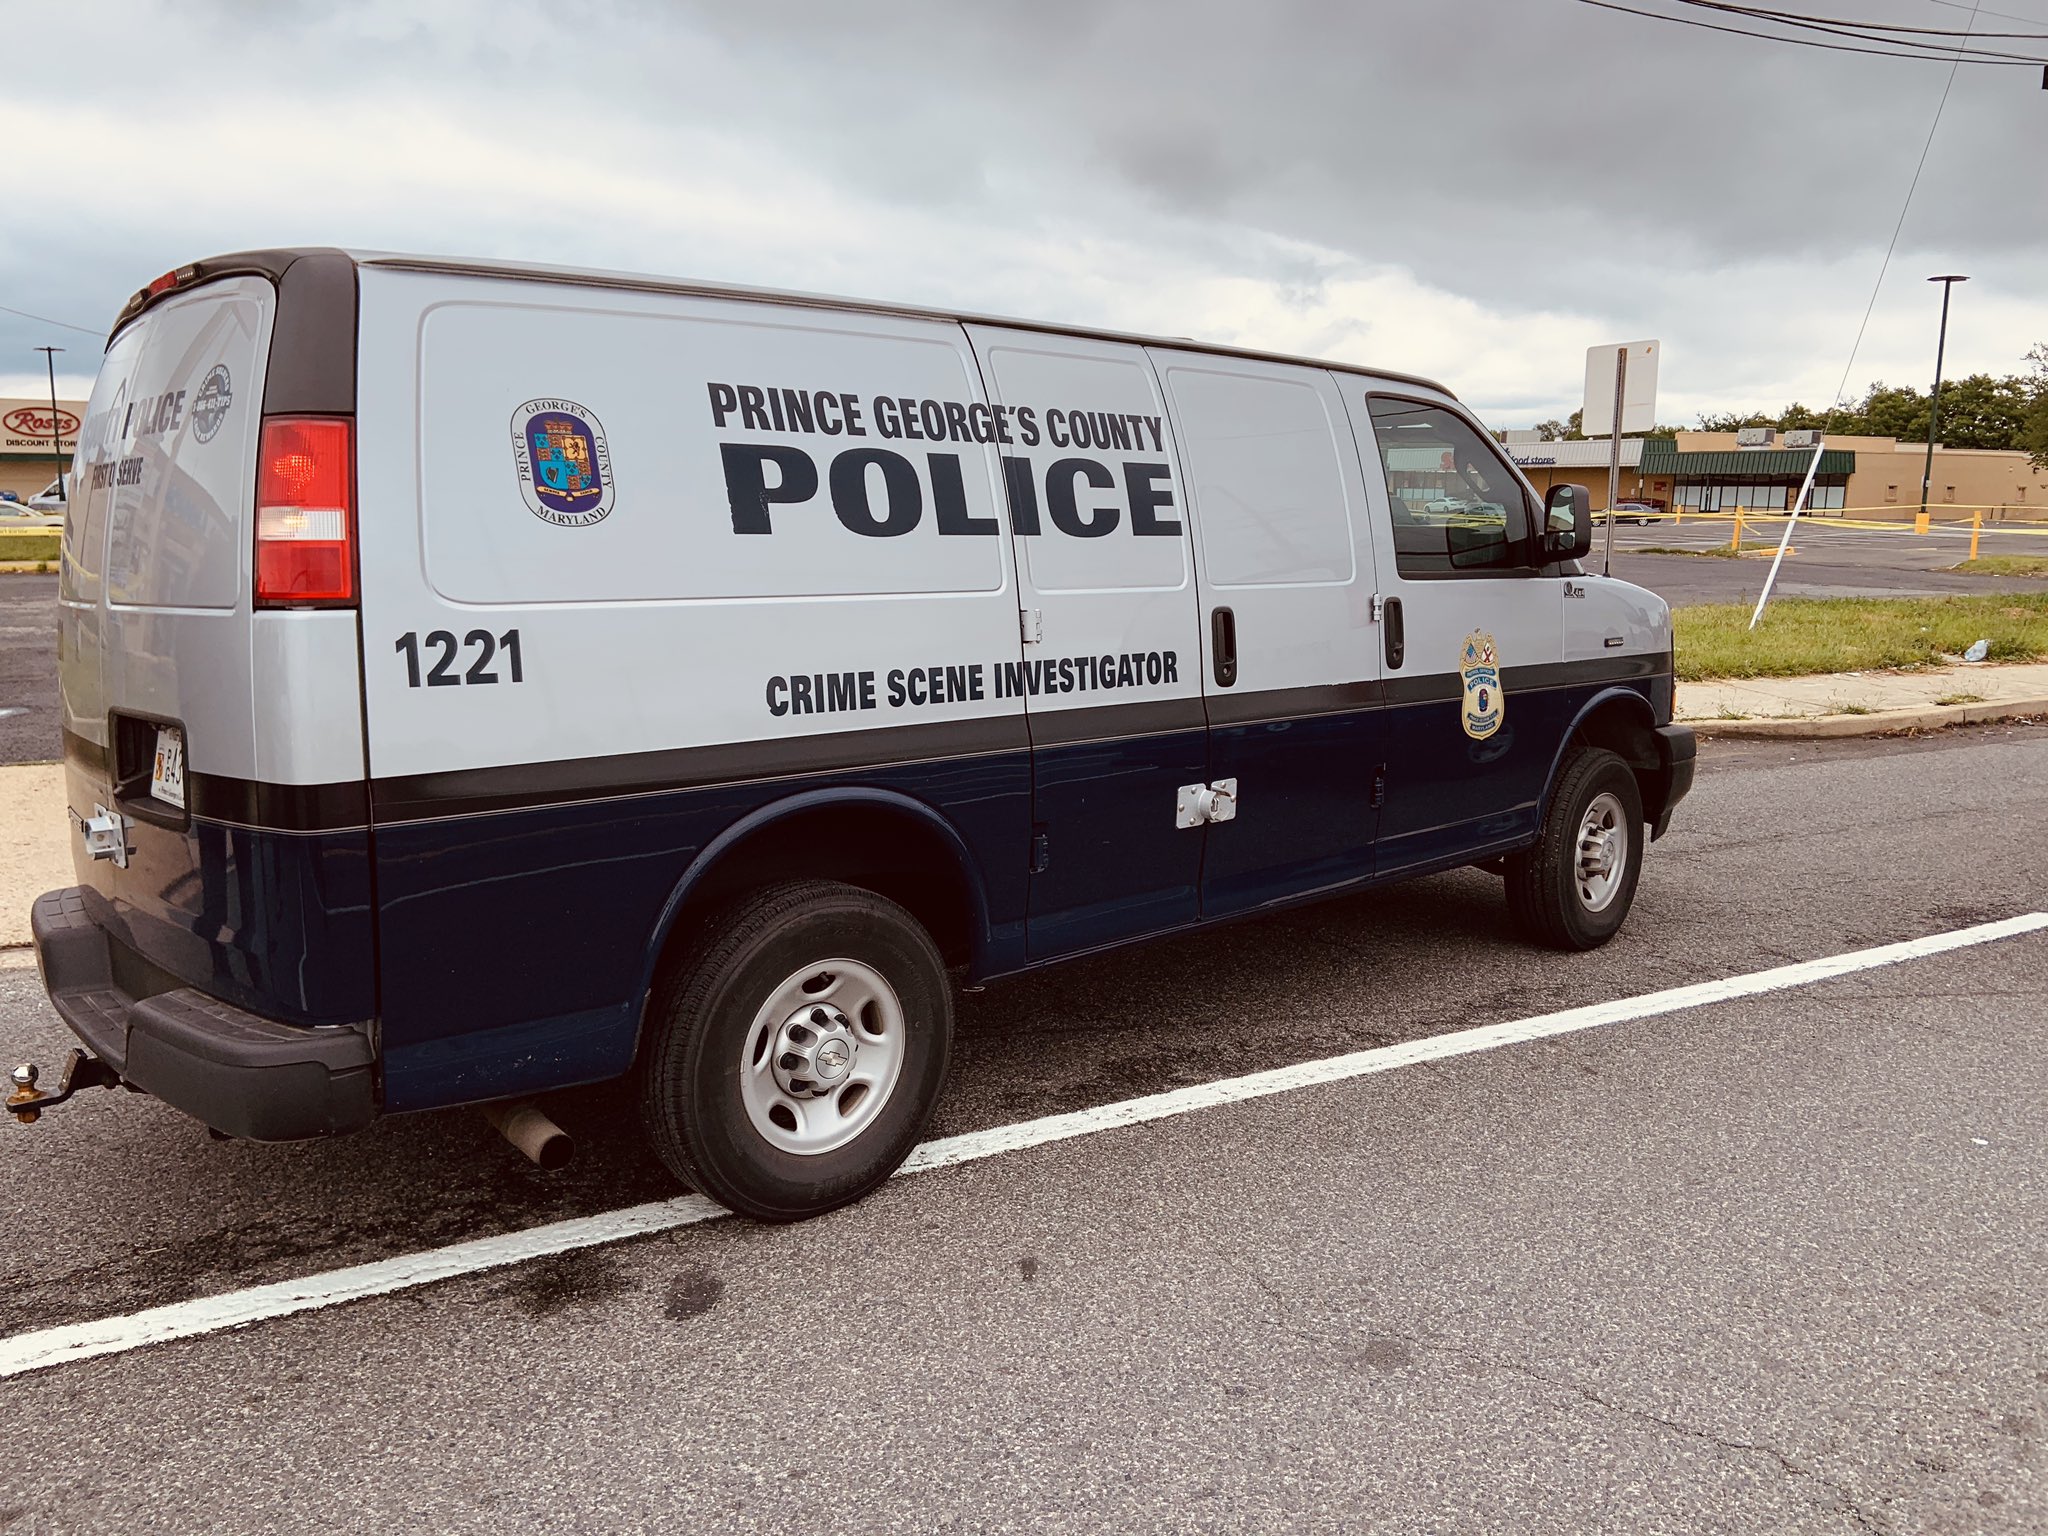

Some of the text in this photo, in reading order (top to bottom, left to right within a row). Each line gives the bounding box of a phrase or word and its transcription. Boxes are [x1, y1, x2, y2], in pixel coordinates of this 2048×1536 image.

[122, 390, 187, 440] POLICE
[707, 382, 1163, 452] PRINCE GEORGE'S COUNTY
[6, 439, 77, 448] DISCOUNT STOR
[514, 400, 612, 489] PRINCE GEORGE'S COUNTY
[1530, 457, 1556, 465] stores
[117, 456, 144, 487] SERVE
[719, 443, 1183, 537] POLICE
[537, 505, 606, 525] MARYLAND
[395, 629, 523, 688] 1221
[766, 650, 1179, 717] CRIME SCENE INVESTIGATOR
[1469, 677, 1494, 689] POLICE
